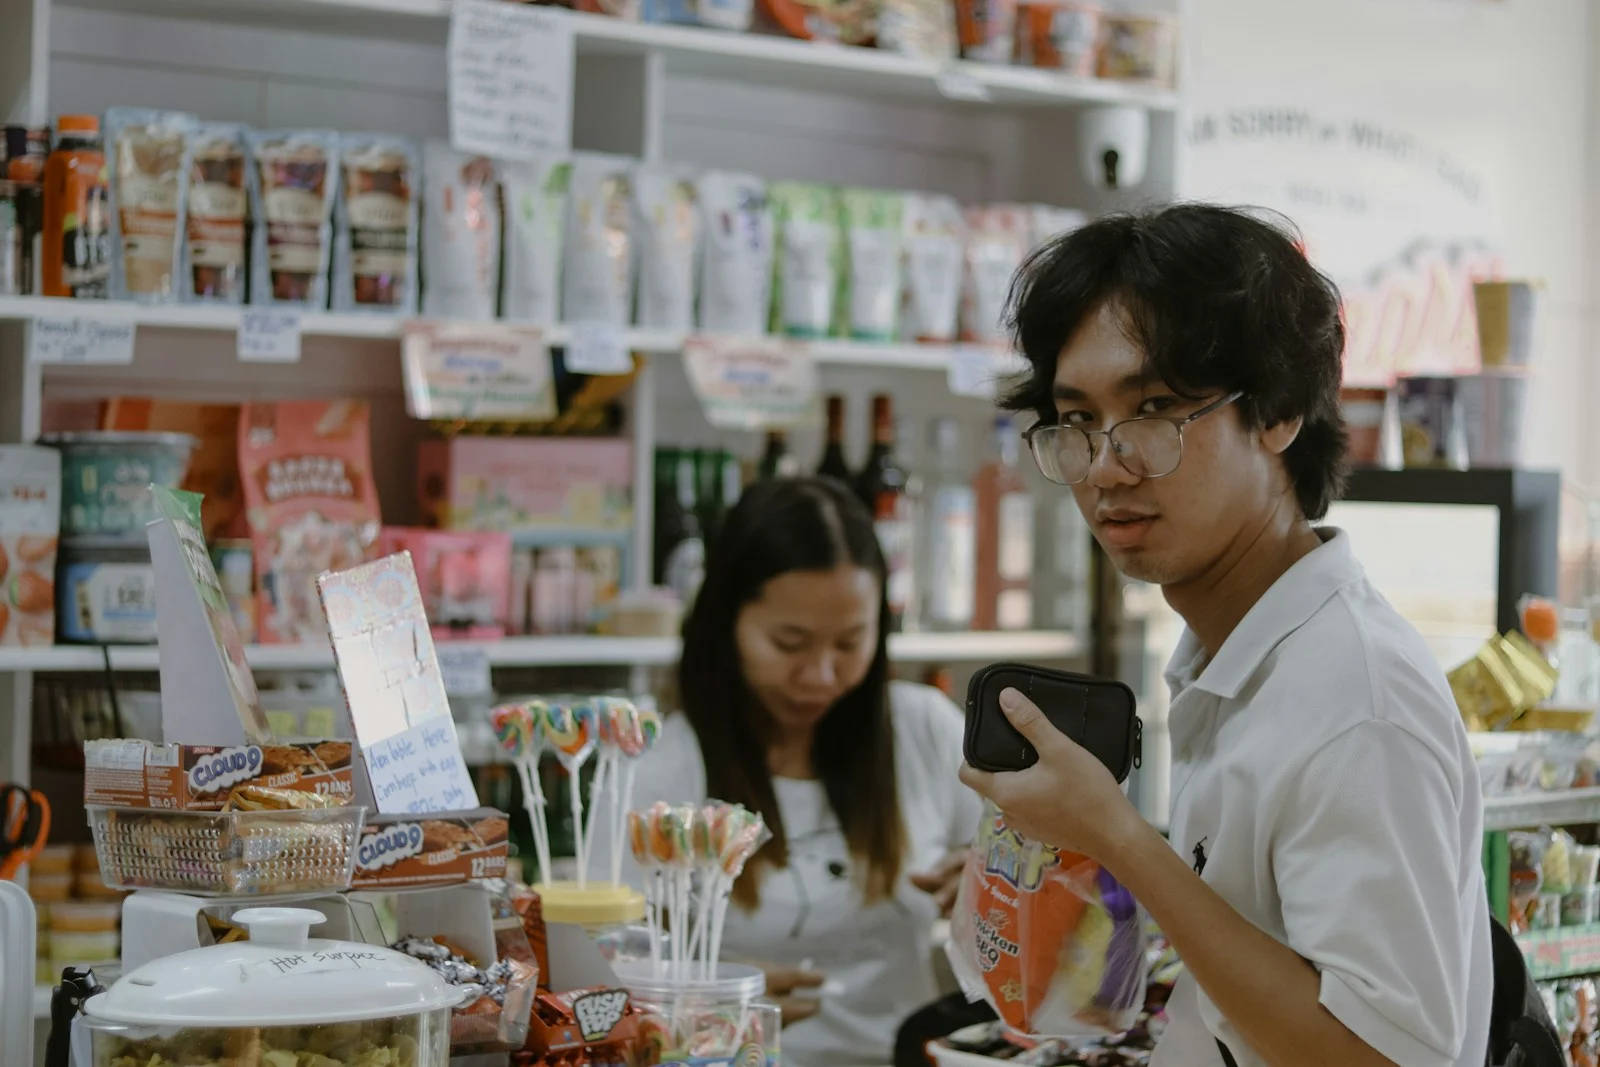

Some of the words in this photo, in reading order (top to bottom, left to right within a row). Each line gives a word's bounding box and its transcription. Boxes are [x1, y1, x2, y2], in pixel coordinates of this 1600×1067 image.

[192, 751, 247, 787] CLOUD
[267, 771, 298, 788] CLASSIC
[329, 780, 352, 793] BARS
[358, 830, 408, 865] CLOUD
[427, 848, 457, 865] CLASSIC
[471, 858, 485, 877] 12
[485, 856, 506, 868] BARS
[269, 953, 307, 974] Hot
[312, 951, 387, 969] Surface
[580, 1010, 622, 1037] POP
